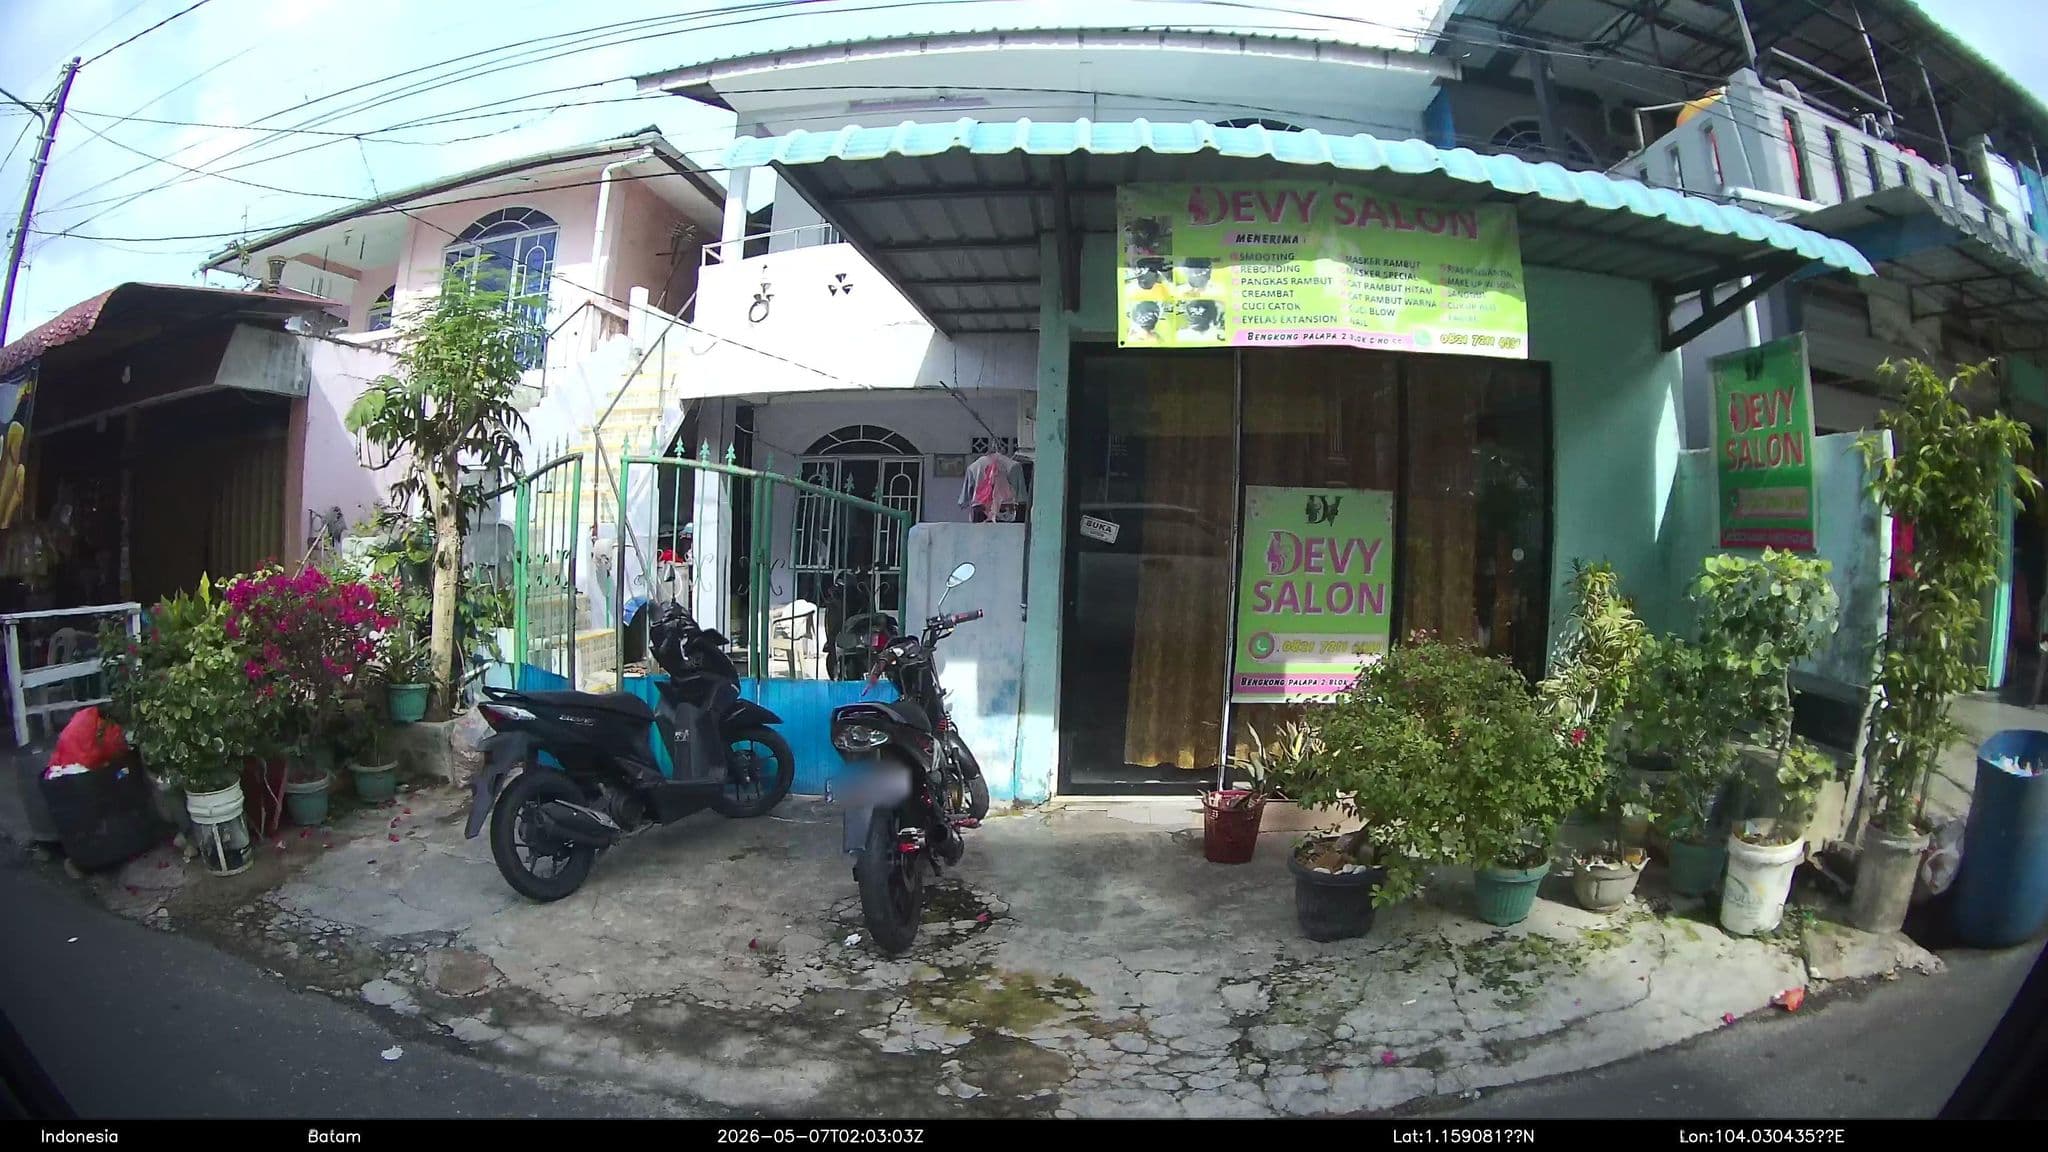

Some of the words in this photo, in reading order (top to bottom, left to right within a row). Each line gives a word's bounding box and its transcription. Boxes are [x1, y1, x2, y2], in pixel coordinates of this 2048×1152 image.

[1188, 184, 1318, 226] DEVY
[1335, 192, 1478, 240] SALON
[1236, 233, 1299, 244] MENERIMA
[1346, 256, 1381, 267] MASKER
[1383, 259, 1420, 269] RAMBUT
[1240, 265, 1301, 274] REBONDING
[1383, 271, 1418, 280] SPECIAL
[1241, 277, 1288, 286] PANGKAS
[1291, 277, 1333, 285] RAMBUT
[1242, 289, 1294, 298] CREAMBAT
[1364, 282, 1402, 292] RAMBUT
[1405, 286, 1433, 295] HITAM
[1242, 302, 1266, 311] CUCI
[1364, 295, 1402, 305] RAMBUT
[1405, 299, 1437, 308] WARNA
[1370, 308, 1395, 316] BLOW
[1247, 332, 1298, 341] BENGKONG
[1729, 386, 1795, 434] DEVY
[1726, 431, 1804, 472] SALON
[1266, 529, 1383, 576] DEVY
[1252, 580, 1385, 616] SALON
[1241, 677, 1285, 686] BENGKONG
